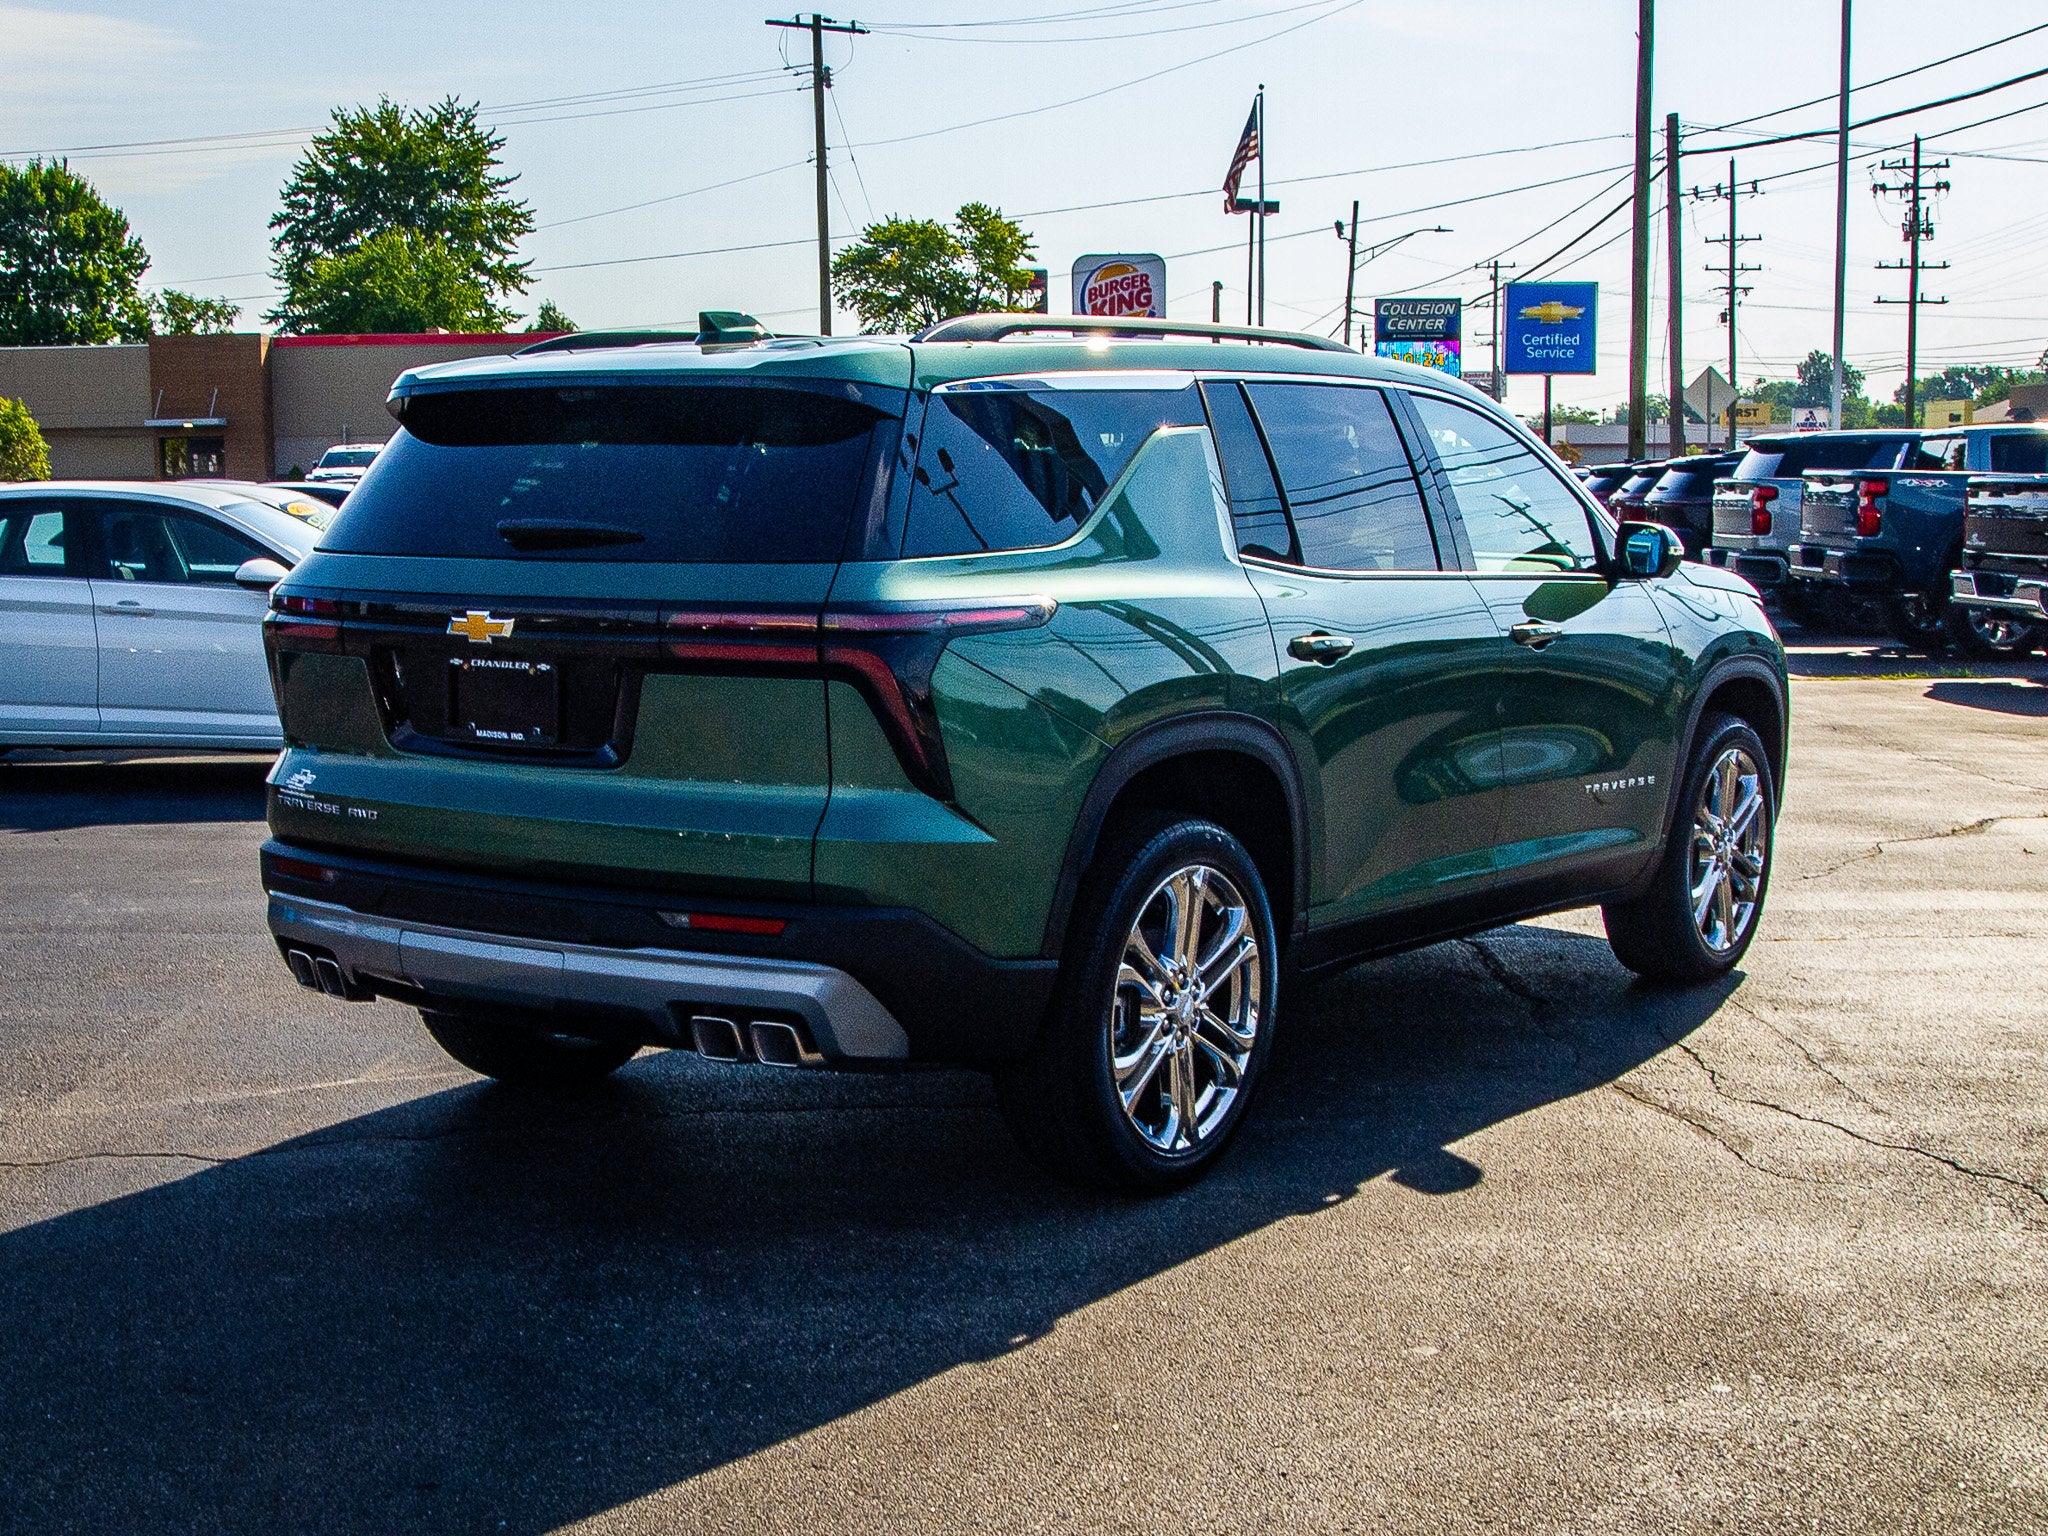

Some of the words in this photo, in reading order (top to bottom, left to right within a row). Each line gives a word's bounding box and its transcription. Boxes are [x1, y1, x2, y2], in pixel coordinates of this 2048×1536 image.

[1088, 273, 1150, 303] BURGER
[1090, 287, 1153, 316] KING
[1380, 303, 1456, 315] COLLISION
[1387, 319, 1445, 330] CENTER
[1522, 334, 1580, 345] Certified
[1526, 347, 1575, 358] Service
[470, 659, 530, 670] CHANDLER
[1584, 775, 1656, 794] TRAVERSE
[277, 794, 340, 815] TRAVERSE
[347, 807, 378, 820] AWD
